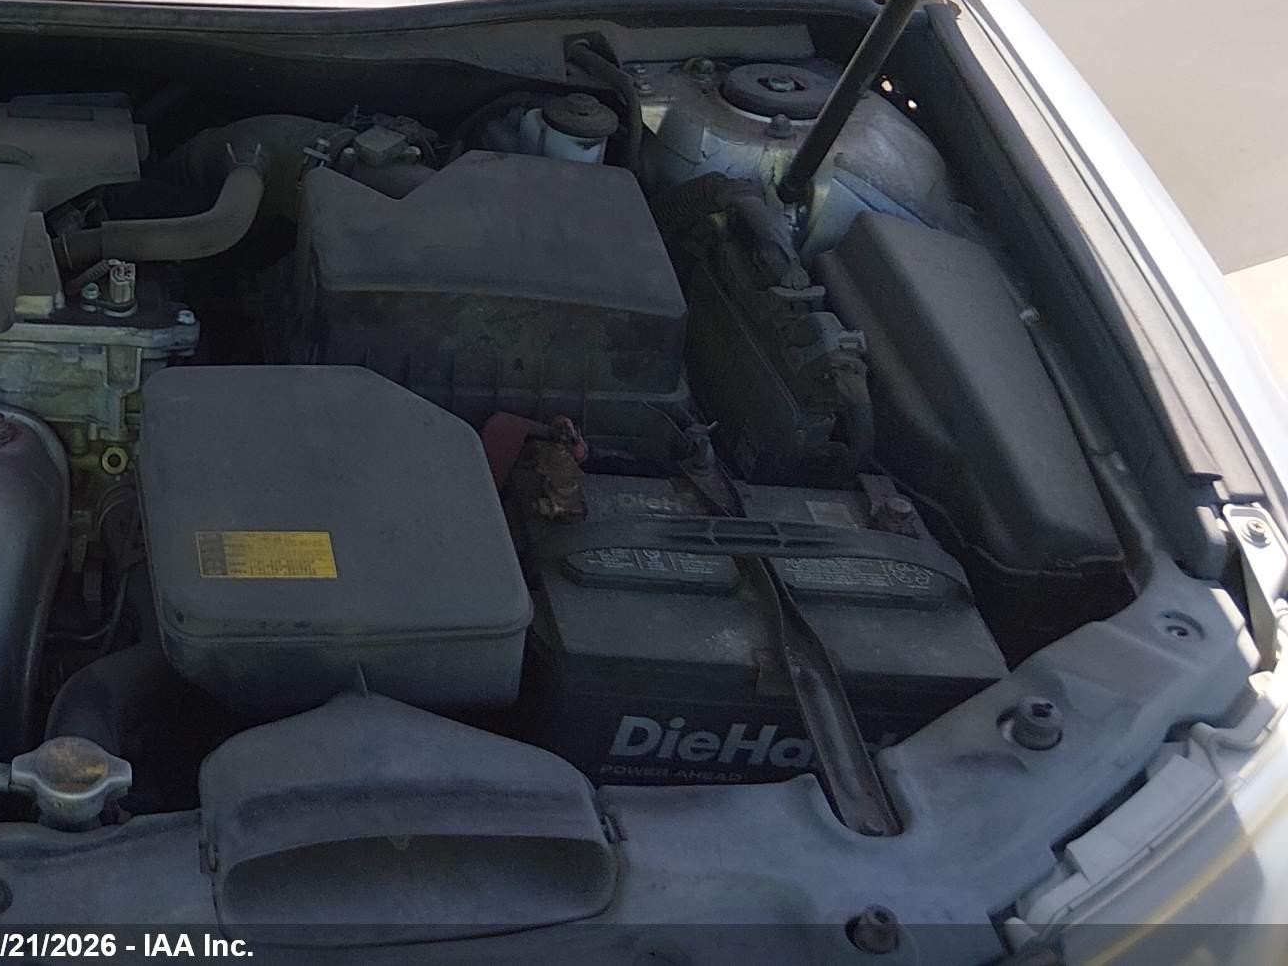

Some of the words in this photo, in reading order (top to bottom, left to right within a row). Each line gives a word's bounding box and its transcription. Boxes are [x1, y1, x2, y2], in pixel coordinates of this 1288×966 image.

[609, 715, 815, 768] DieHa
[599, 762, 669, 778] POWER
[673, 768, 743, 781] AHEAD
